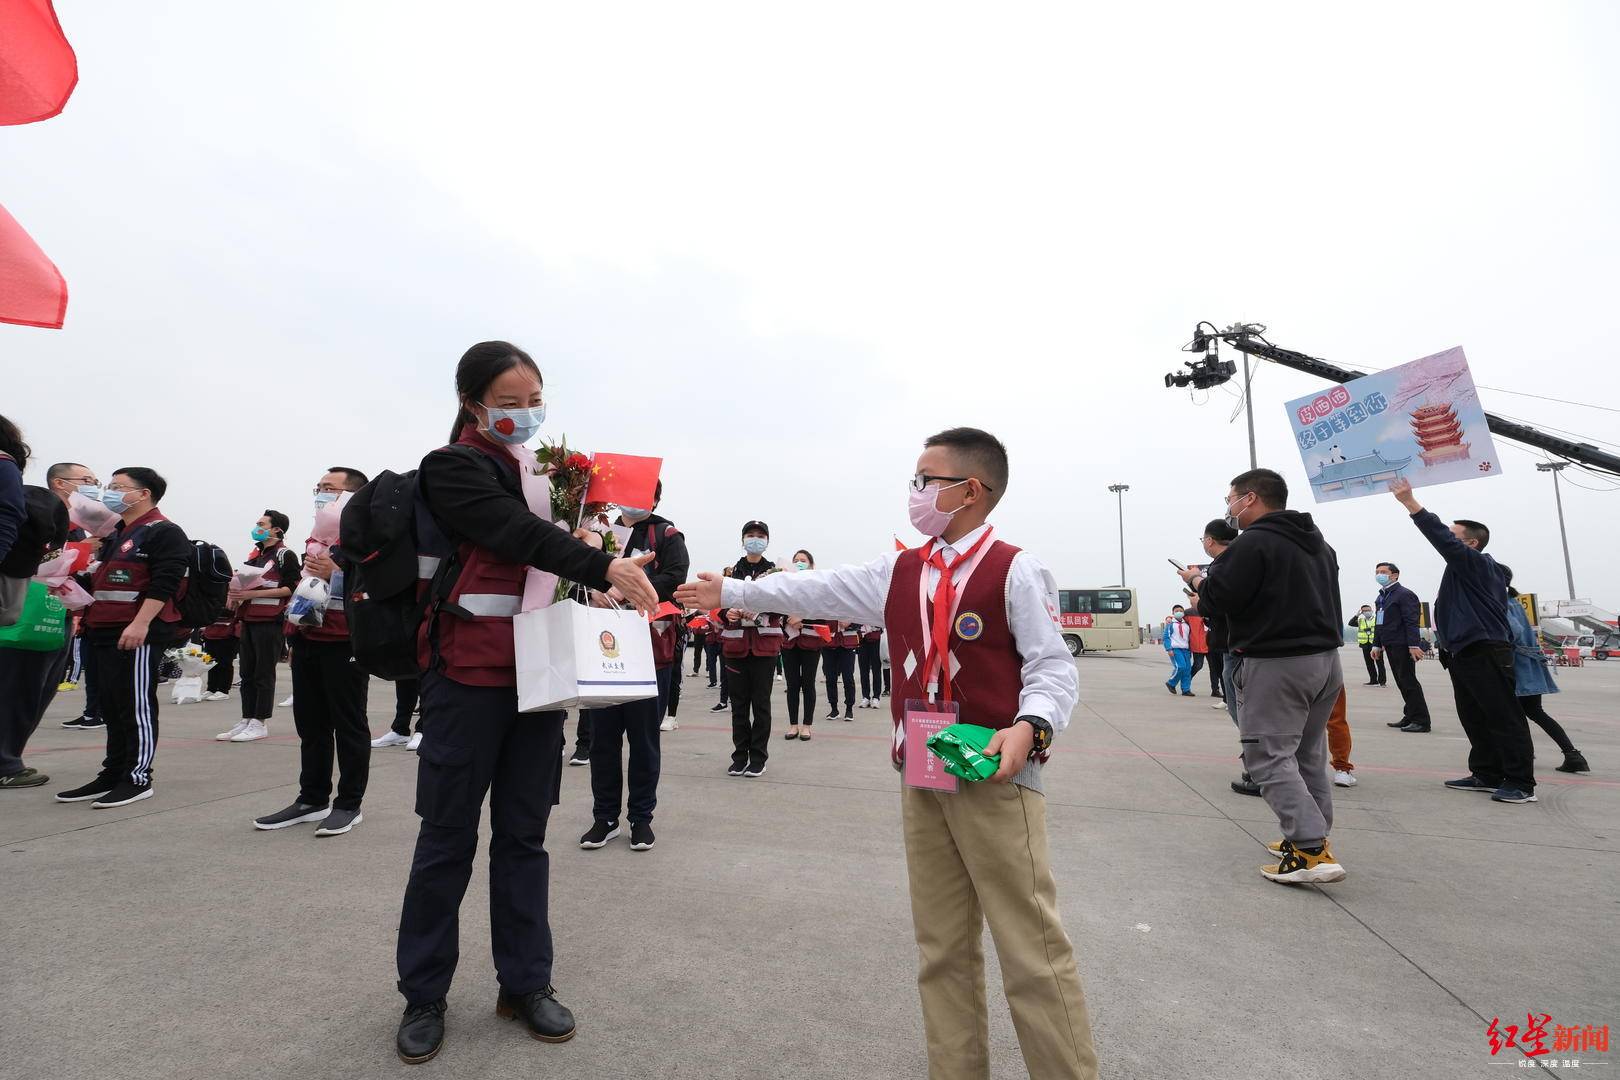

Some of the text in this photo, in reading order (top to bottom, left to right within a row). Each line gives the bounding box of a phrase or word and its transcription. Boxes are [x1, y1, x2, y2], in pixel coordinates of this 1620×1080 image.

[1298, 392, 1389, 449] 终于等到你
